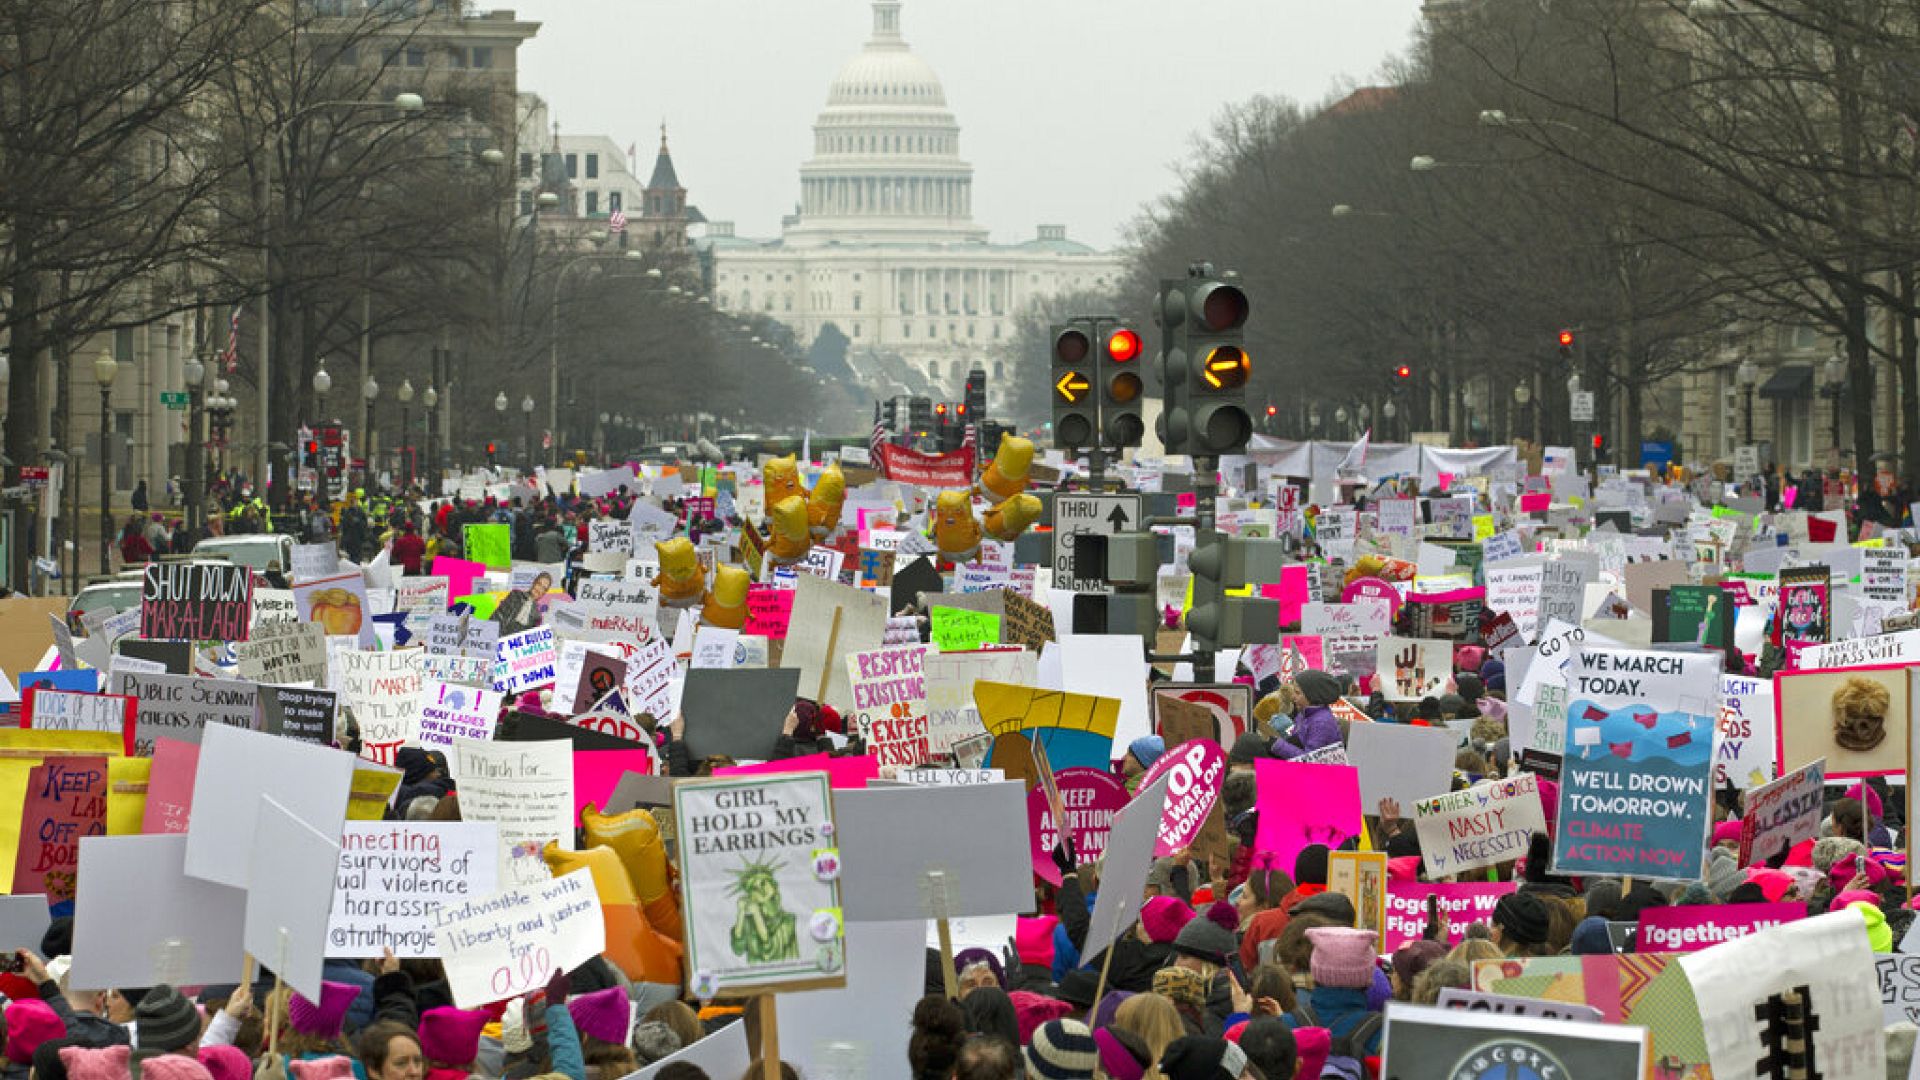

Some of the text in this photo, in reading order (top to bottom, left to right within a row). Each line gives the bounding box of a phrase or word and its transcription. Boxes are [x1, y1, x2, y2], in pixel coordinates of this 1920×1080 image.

[1060, 501, 1099, 518] THRU
[144, 563, 249, 602] SHUT DOWN
[142, 601, 246, 640] MAR-A-LAGO
[1539, 627, 1585, 657] GO TO
[857, 648, 927, 680] RESPECT
[1580, 652, 1684, 675] WE MARCH
[123, 675, 257, 707] PUBLIC SERVANT
[277, 690, 333, 707] Stop trying
[1578, 677, 1646, 698] TODAY.
[284, 706, 324, 718] to make
[891, 702, 912, 719] OR
[282, 721, 302, 730] the
[871, 715, 928, 743] EXPECT
[41, 764, 101, 801] KEEP
[903, 769, 992, 785] TELL YOUR
[1168, 755, 1223, 821] WAR ON
[1572, 769, 1703, 795] WE'LL DROWN
[715, 788, 780, 810] GIRL,
[1060, 787, 1096, 807] KEEP
[1416, 792, 1475, 817] MOTHER
[1489, 777, 1536, 800] CHOICE
[1570, 794, 1692, 819] TOMORROW.
[692, 806, 811, 834] HOLD MY
[1162, 785, 1217, 846] WOMEN
[39, 817, 79, 844] OFF
[694, 826, 816, 855] EARRINGS
[1567, 821, 1644, 841] CLIMATE
[1453, 826, 1533, 864] NECESSITY
[1565, 844, 1690, 868] ACTION NOW.
[341, 850, 473, 875] survivors of
[382, 873, 468, 894] violence
[1386, 894, 1471, 915] Togeher
[448, 923, 513, 952] liberty
[517, 914, 544, 935] and
[1388, 915, 1428, 937] Figh
[1645, 920, 1748, 948] Together
[510, 941, 534, 960] for
[491, 946, 550, 995] all
